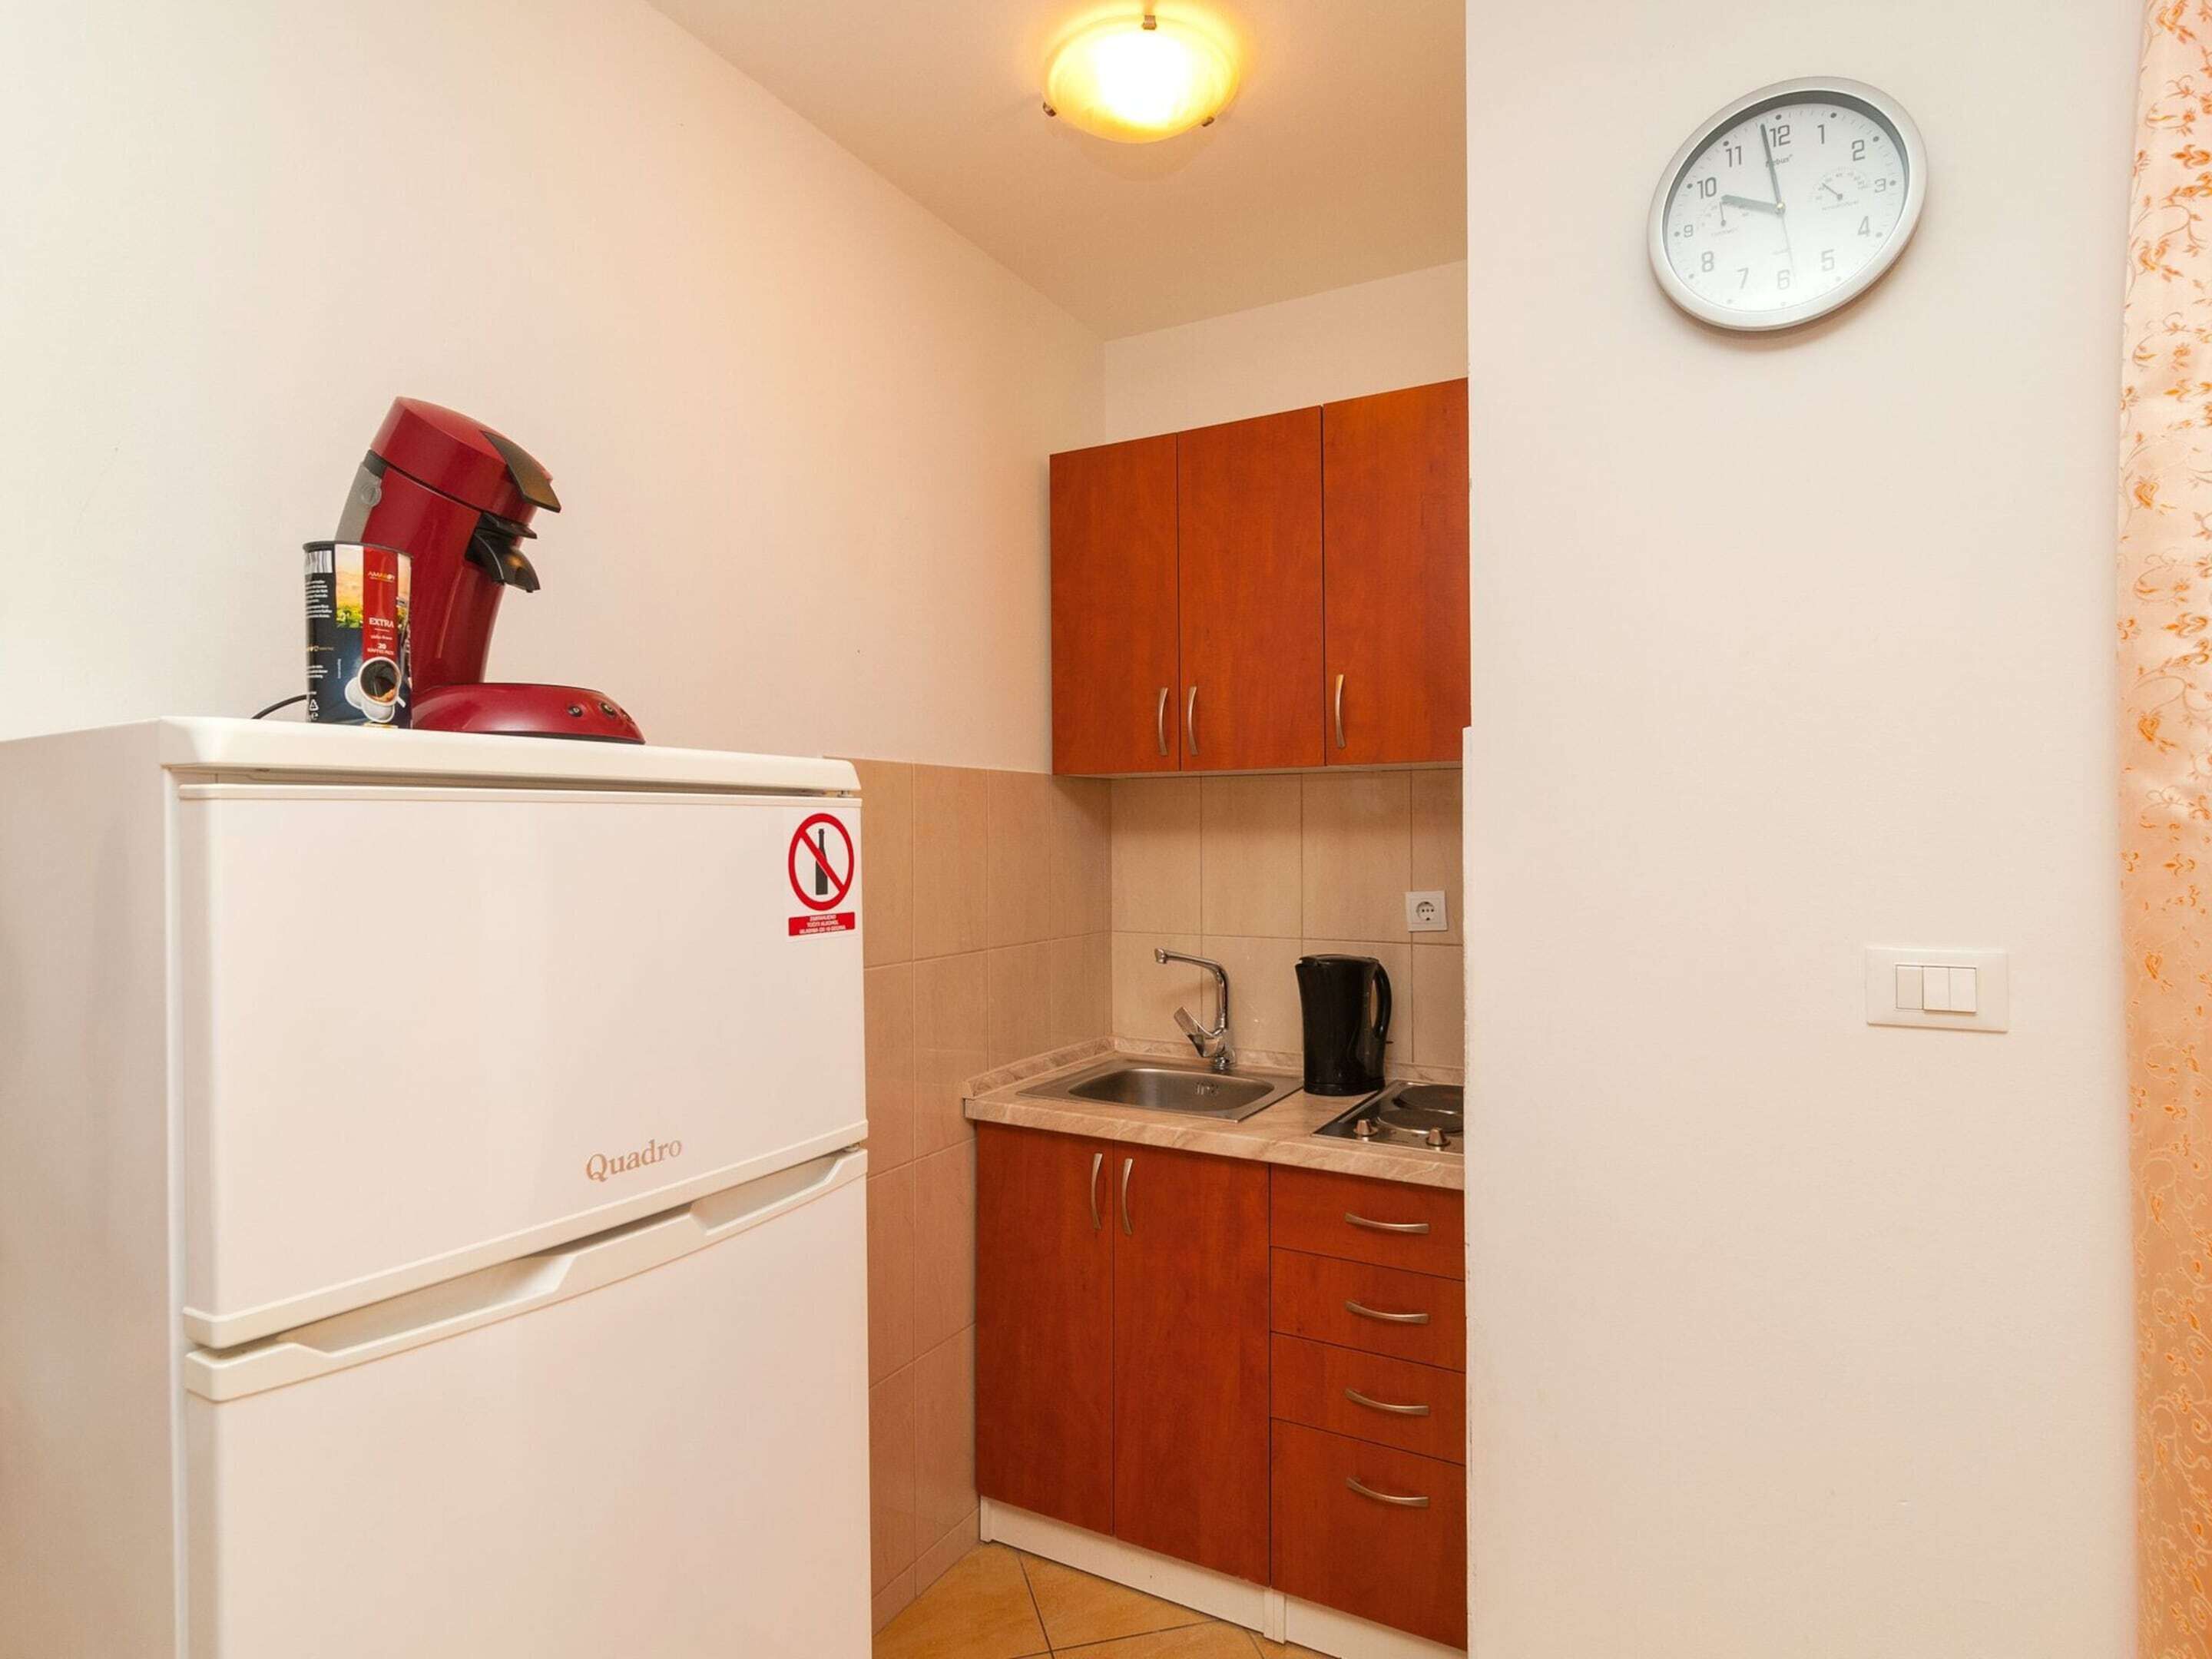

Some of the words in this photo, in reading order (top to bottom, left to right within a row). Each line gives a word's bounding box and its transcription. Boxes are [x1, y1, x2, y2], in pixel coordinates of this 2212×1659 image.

[1770, 124, 1791, 147] 12
[1817, 124, 1825, 144] 1
[1726, 146, 1742, 167] 11
[1852, 139, 1865, 161] 2
[1697, 177, 1717, 199] 10
[1874, 178, 1886, 193] 3
[1684, 224, 1694, 238] 9
[1857, 216, 1870, 237] 4
[1701, 251, 1714, 273] 8
[1821, 249, 1835, 272] 5
[1737, 267, 1749, 290] 7
[1777, 270, 1790, 290] 6
[369, 617, 395, 628] EXTRA
[585, 1138, 683, 1183] Quadro
